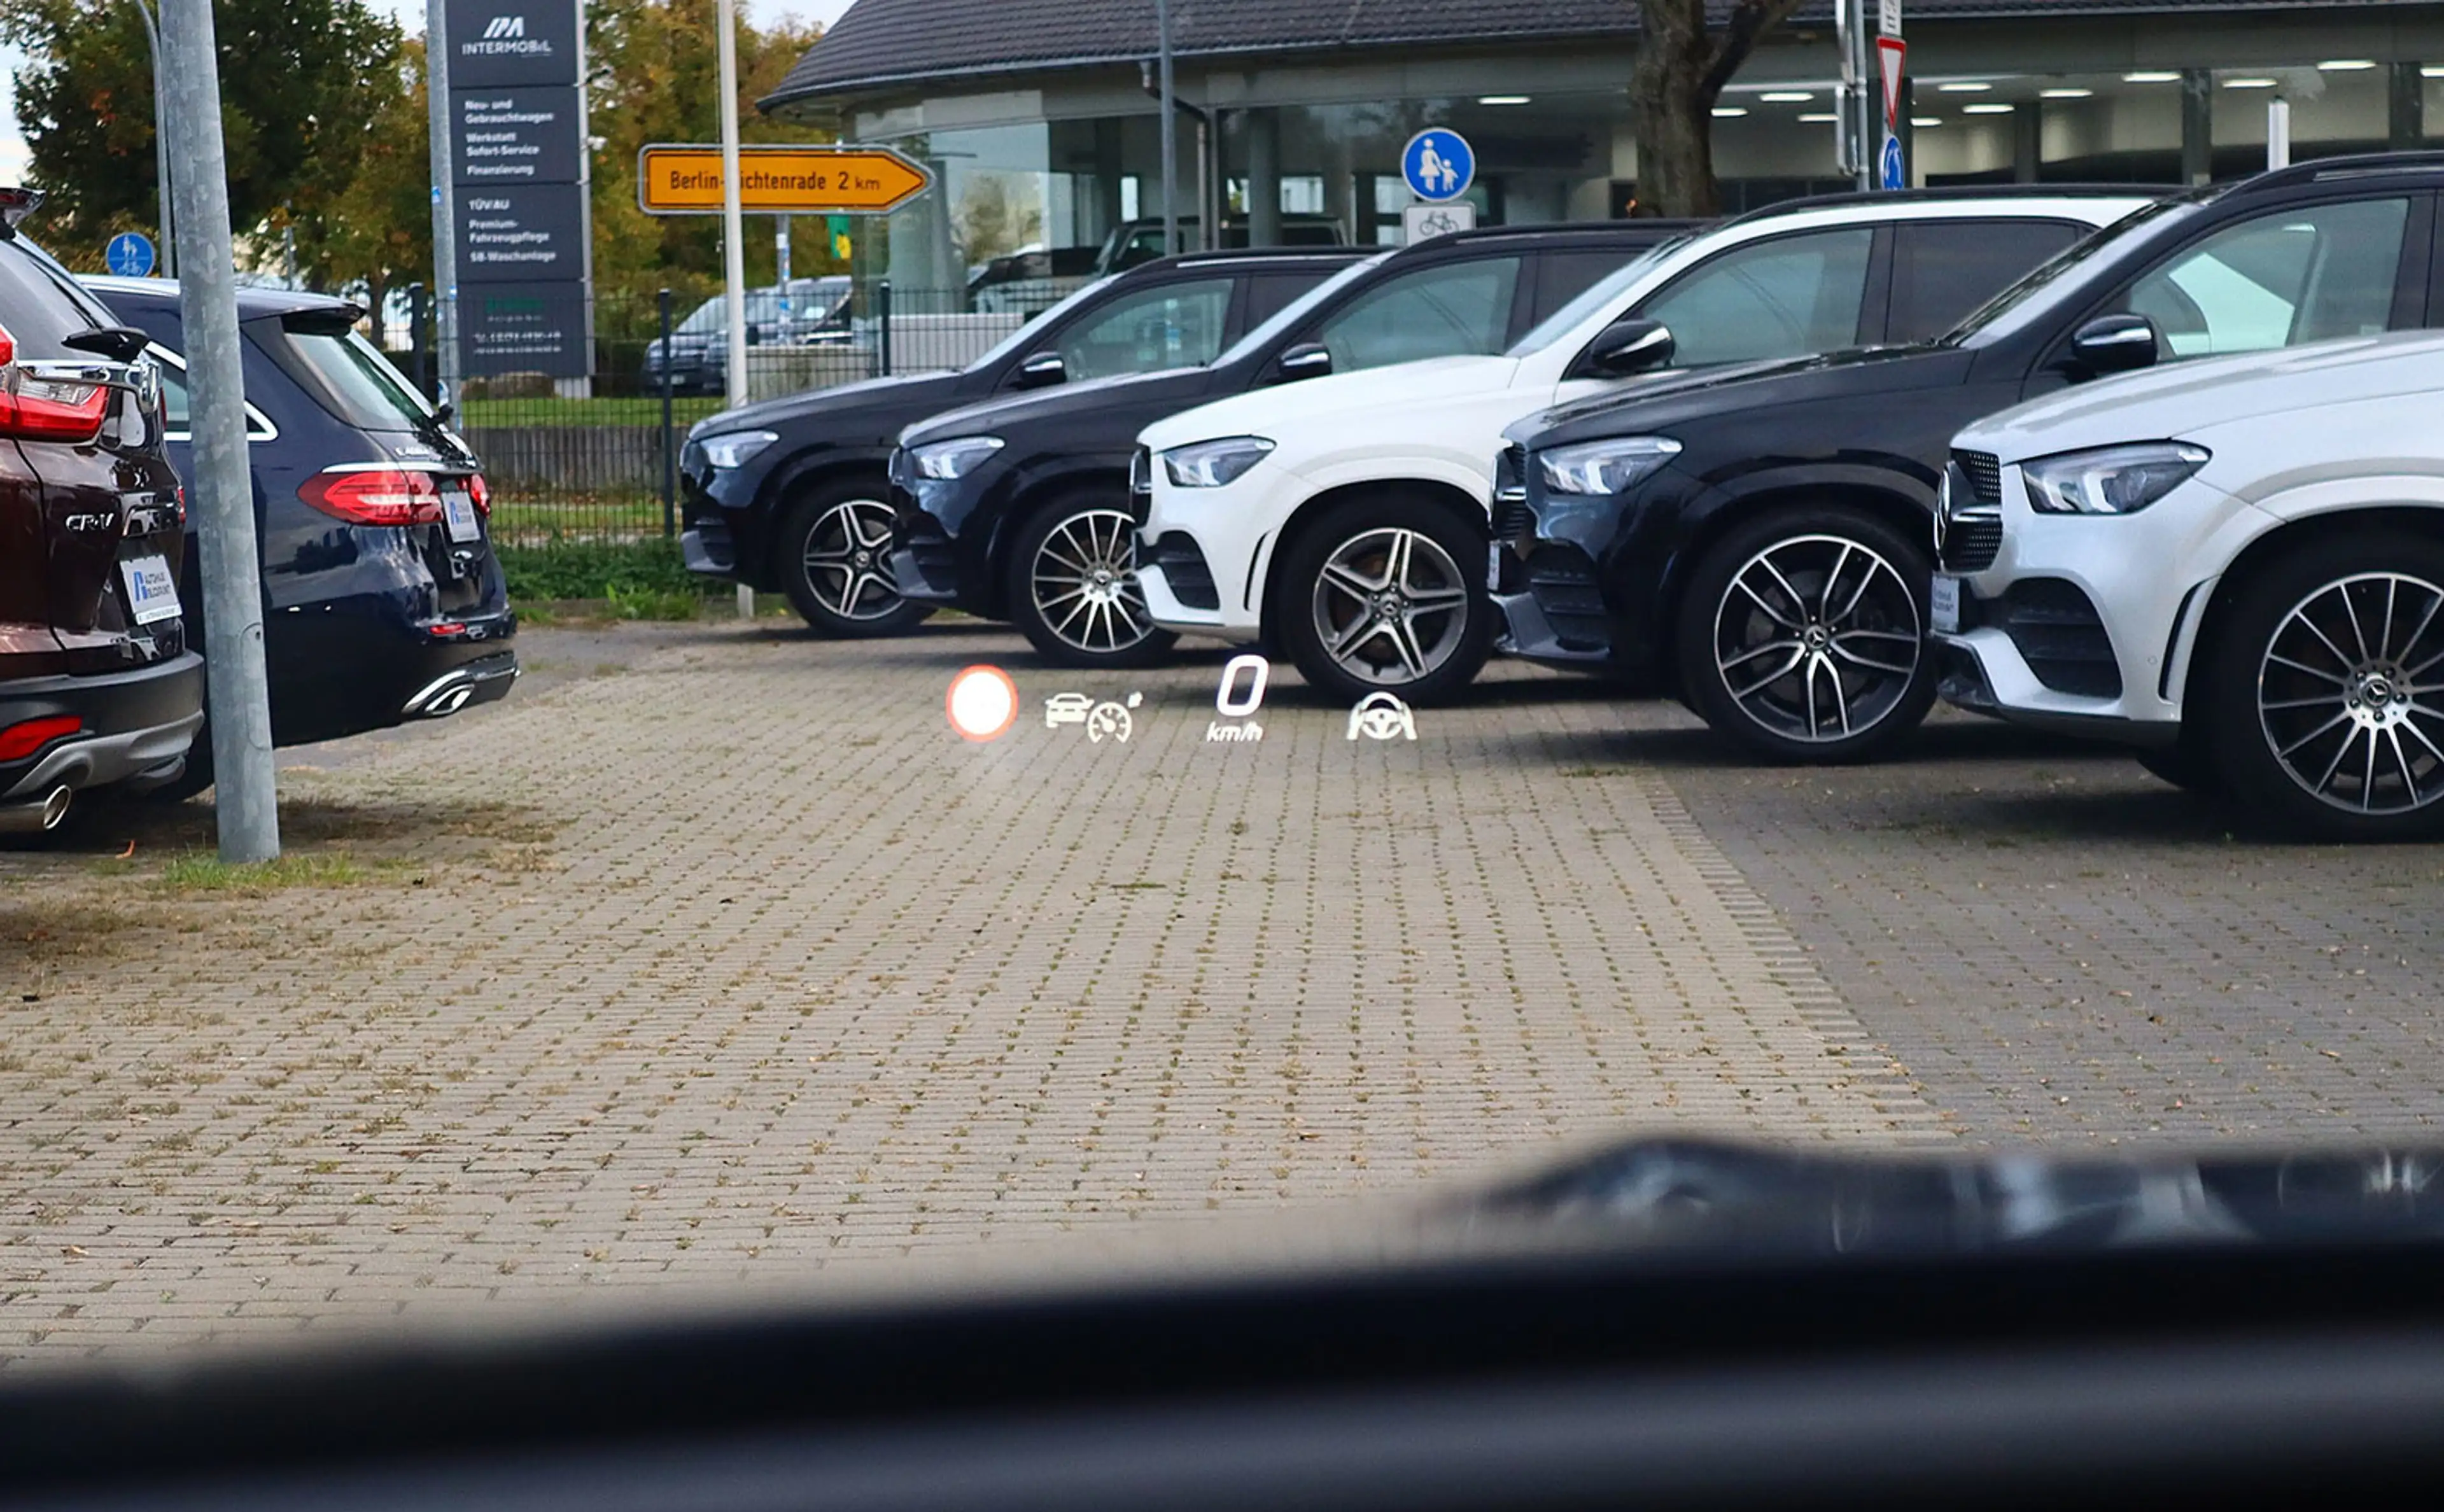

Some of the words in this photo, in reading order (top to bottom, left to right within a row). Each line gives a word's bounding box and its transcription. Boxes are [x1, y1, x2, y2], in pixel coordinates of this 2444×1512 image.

[491, 99, 512, 109] und
[465, 113, 554, 125] Gebrauchtwagen
[466, 132, 517, 143] Werkstatt
[467, 164, 535, 176] Finanzierung
[670, 171, 826, 190] Berlin-ichtenrade
[838, 171, 849, 190] 2
[855, 176, 880, 190] km
[469, 231, 550, 244] Fahrzeugpflege
[1216, 654, 1269, 717] 0
[1206, 720, 1263, 742] km/h
